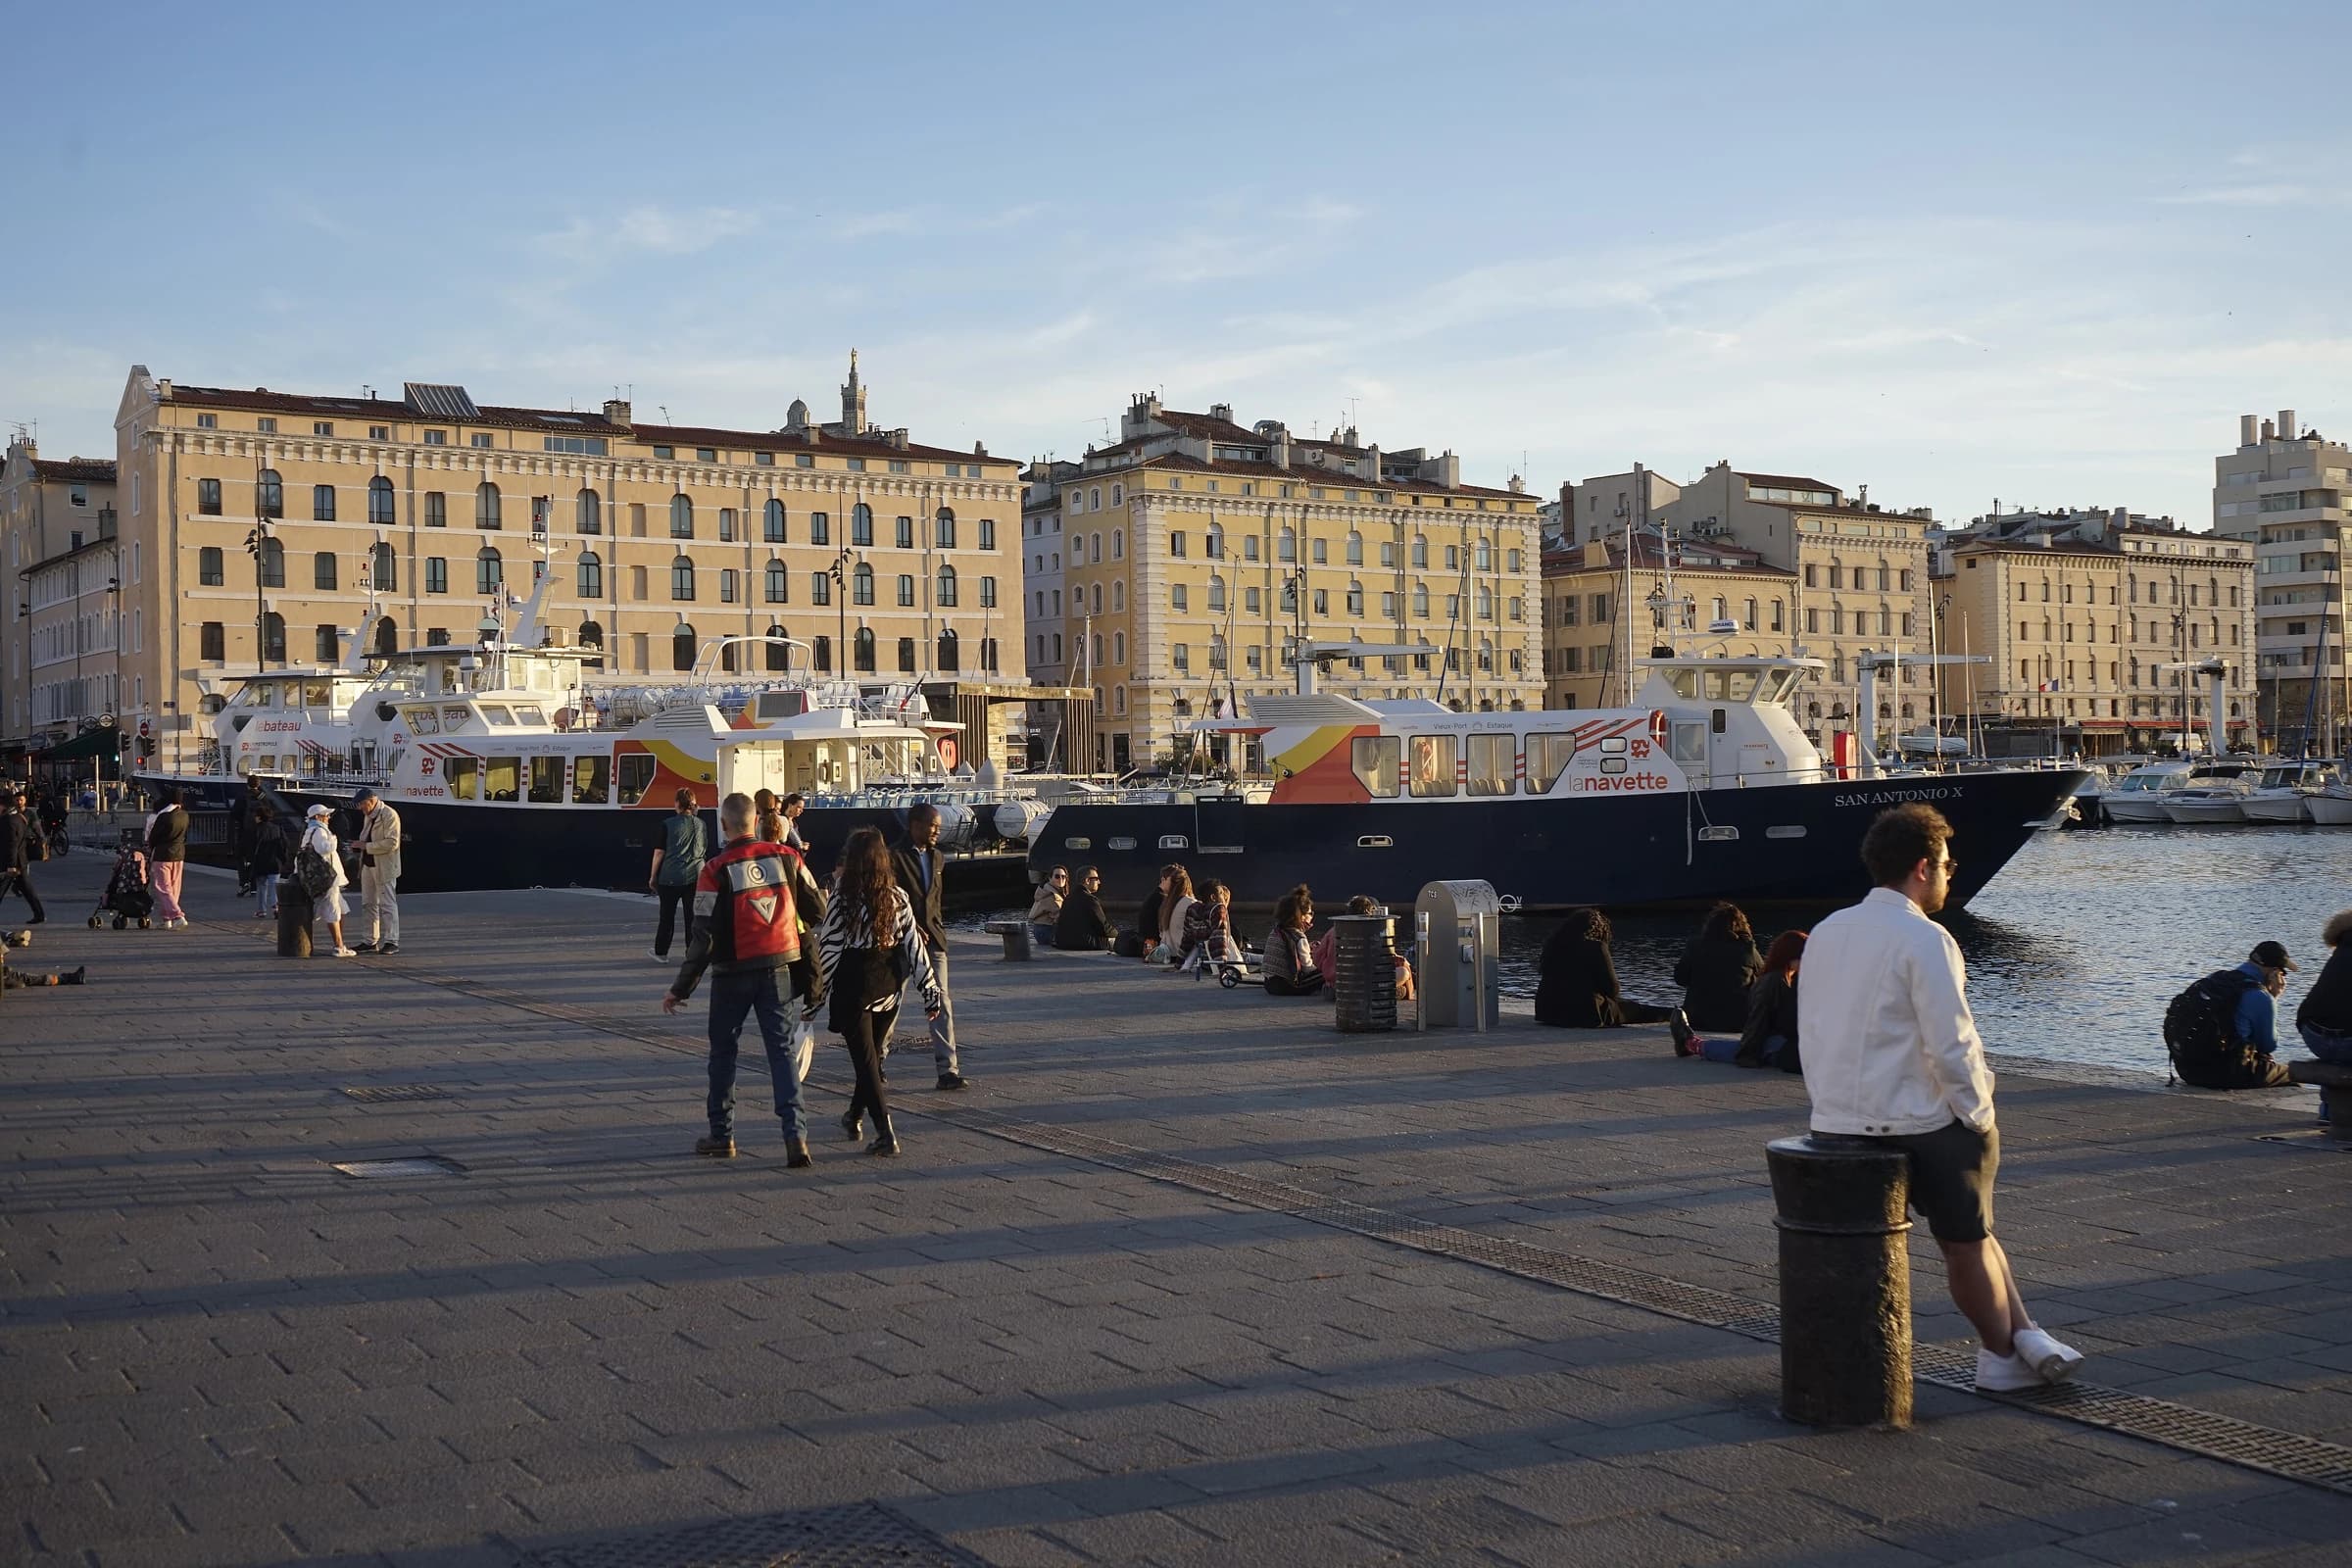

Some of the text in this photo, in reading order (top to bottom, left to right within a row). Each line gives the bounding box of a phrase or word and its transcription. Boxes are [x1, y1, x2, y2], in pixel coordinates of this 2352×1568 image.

[1569, 771, 1668, 792] lanavette
[1835, 787, 1964, 808] SAN ANTONIO X
